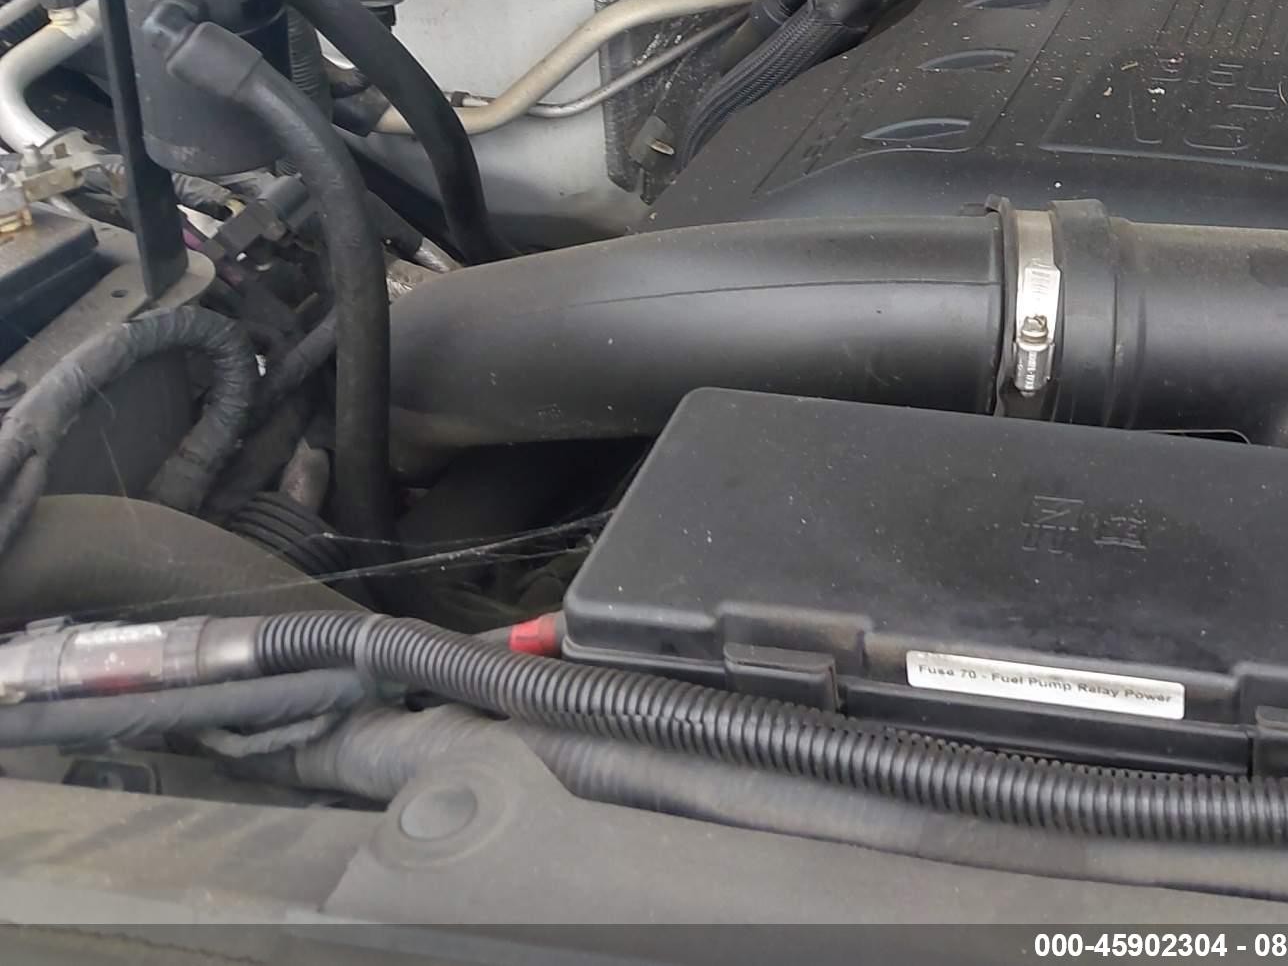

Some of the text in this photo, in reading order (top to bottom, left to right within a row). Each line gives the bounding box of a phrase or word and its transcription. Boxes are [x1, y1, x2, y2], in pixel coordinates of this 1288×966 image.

[917, 664, 955, 677] Fuse
[960, 668, 977, 679] 70
[990, 672, 1024, 685] Fuel
[1028, 677, 1073, 692] Pump
[1077, 683, 1119, 699] Relay
[1123, 689, 1173, 703] Power
